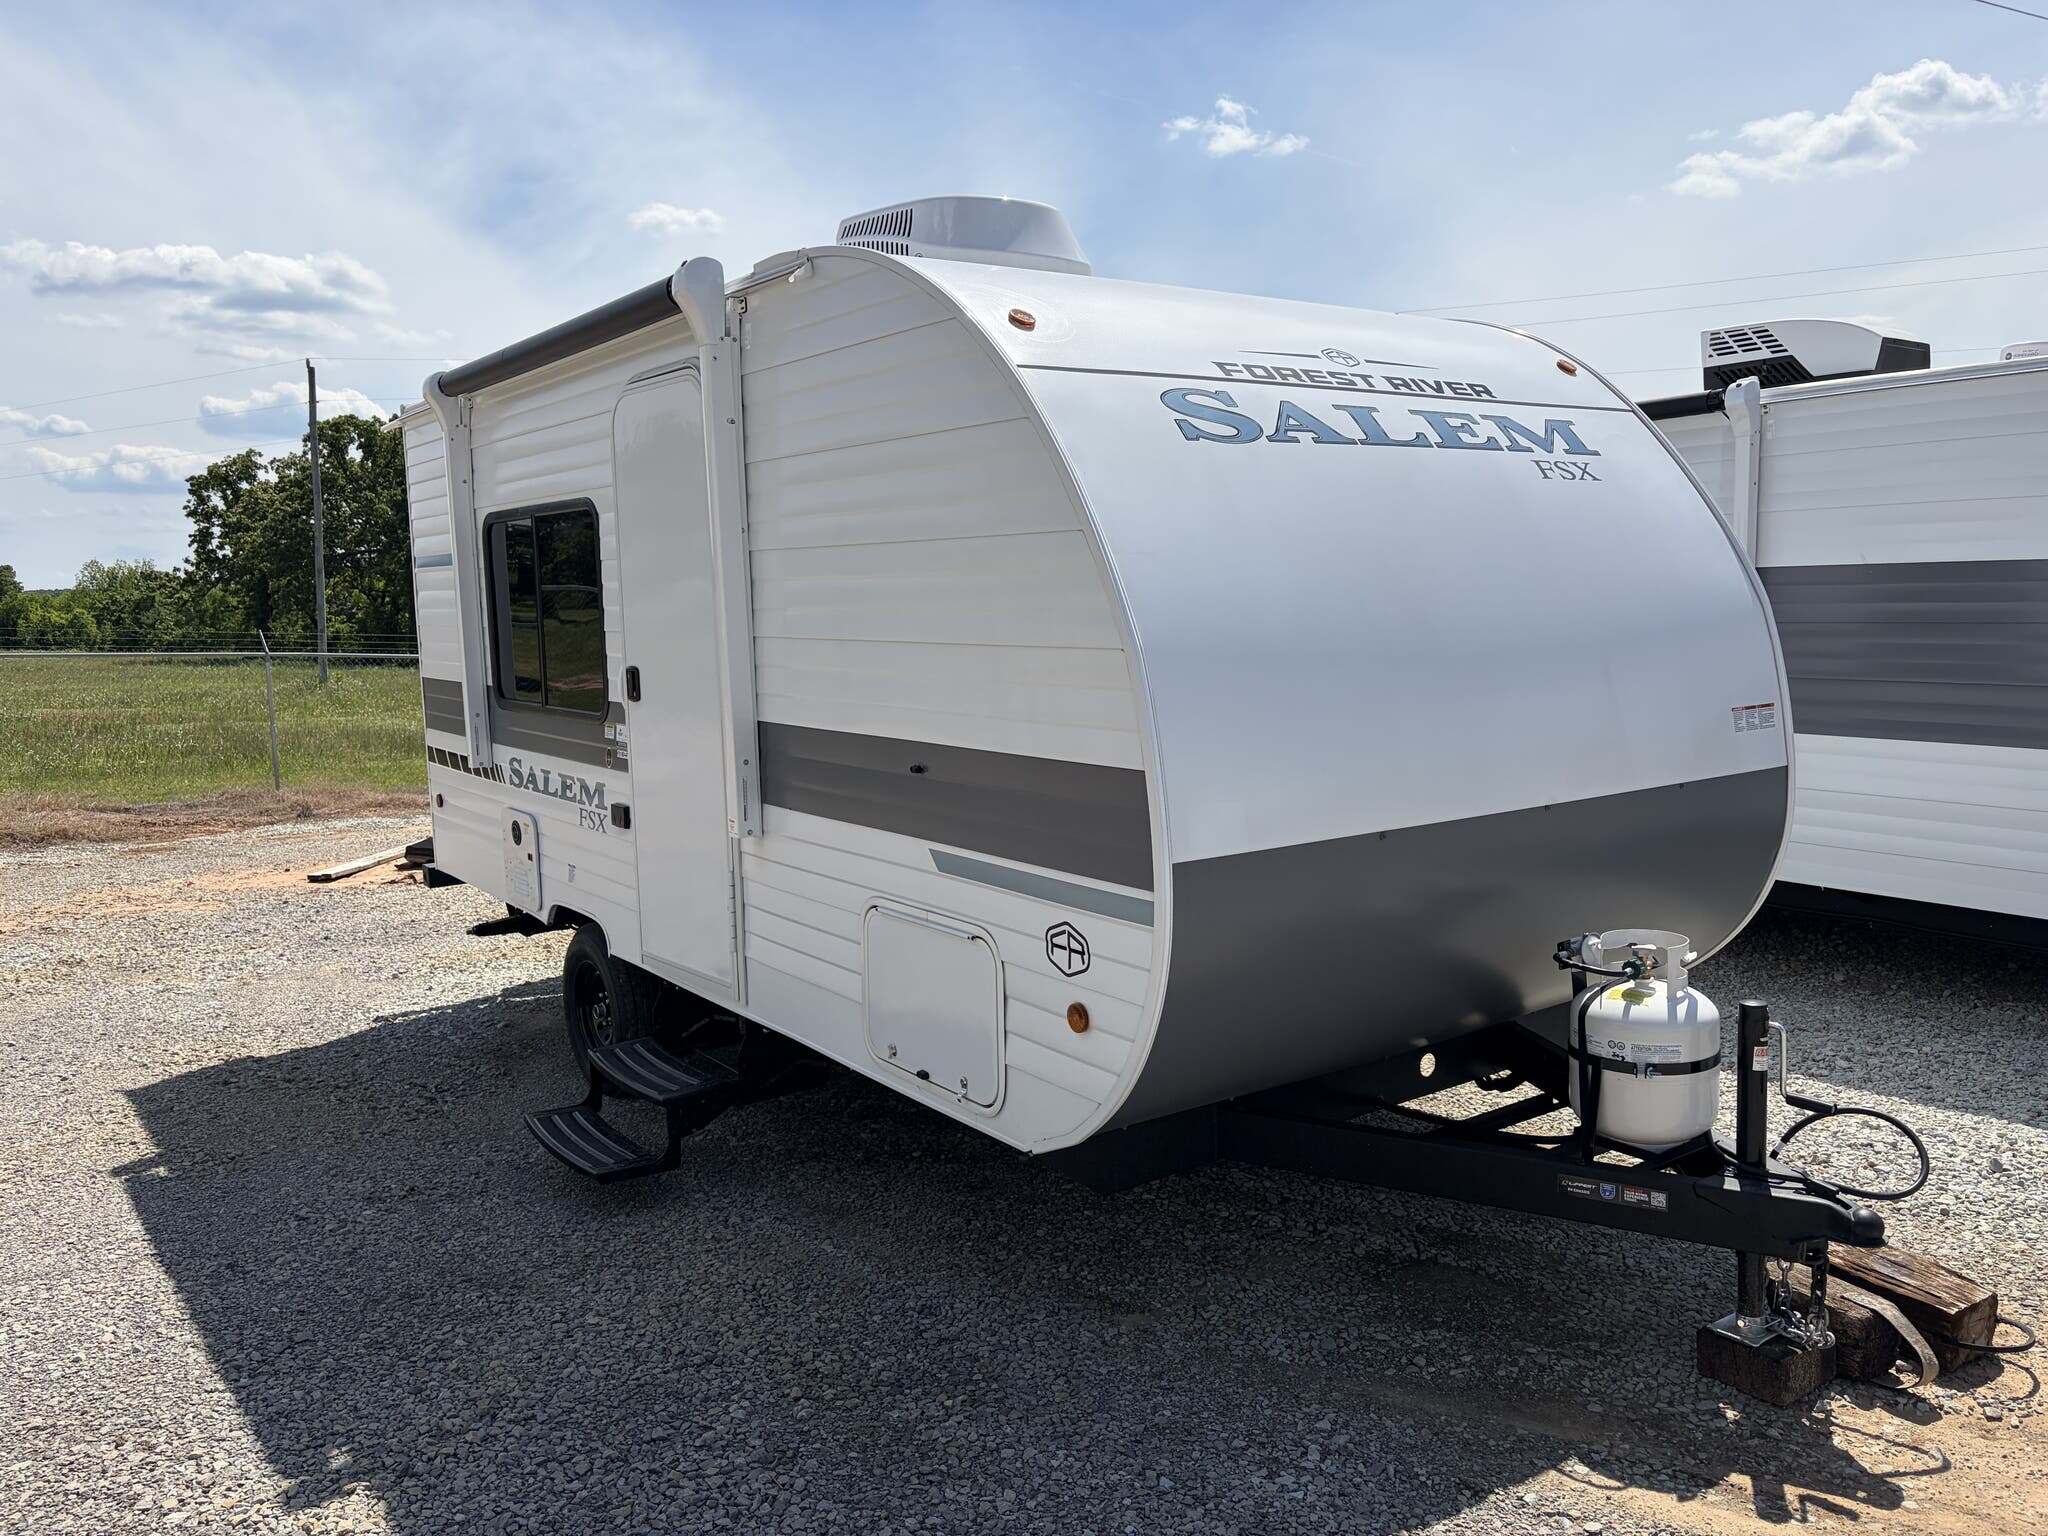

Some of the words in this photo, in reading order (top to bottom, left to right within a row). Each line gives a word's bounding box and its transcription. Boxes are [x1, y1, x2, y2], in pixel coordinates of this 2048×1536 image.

[1212, 361, 1375, 388] FOREST
[1381, 376, 1498, 398] RIVER
[1159, 387, 1602, 456] SALEM
[1530, 459, 1603, 482] FSX
[508, 757, 608, 810] SALEM
[579, 807, 608, 834] FSX
